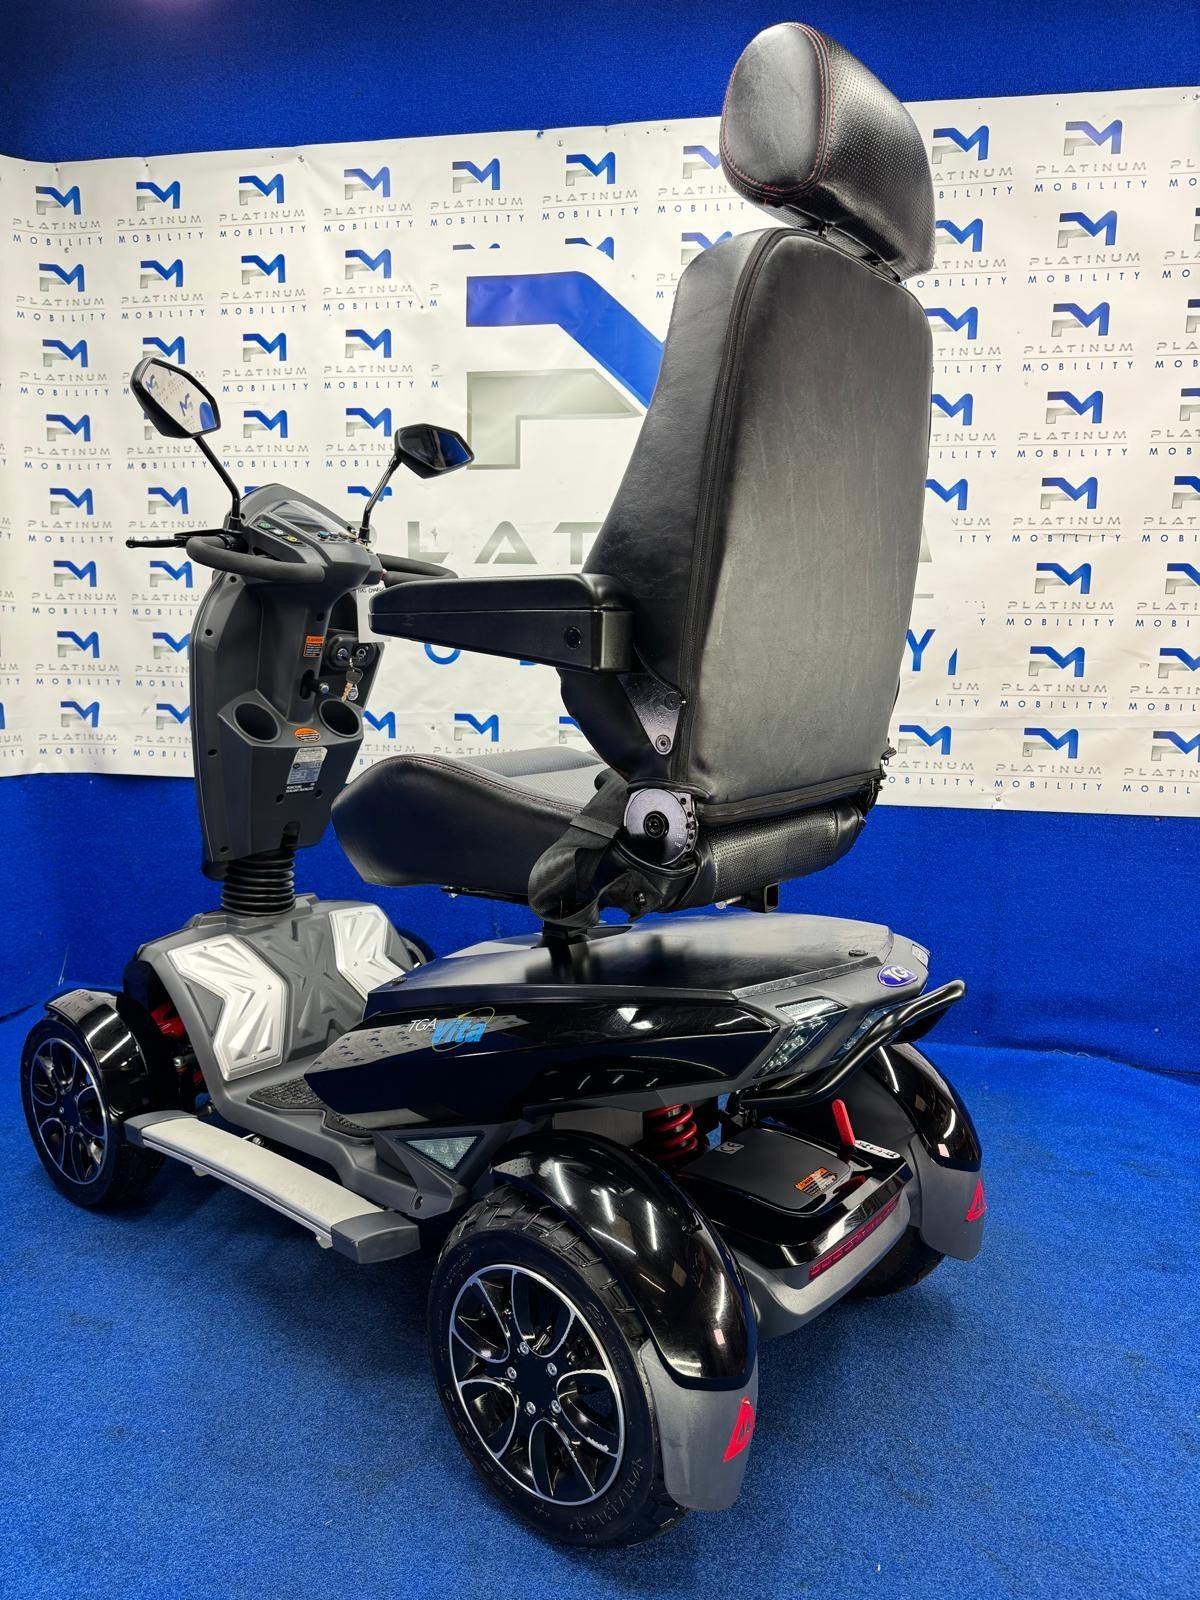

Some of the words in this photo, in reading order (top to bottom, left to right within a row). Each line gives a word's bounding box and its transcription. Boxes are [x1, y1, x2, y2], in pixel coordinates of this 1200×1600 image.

[1036, 162, 1146, 174] PLATINUM
[1034, 180, 1147, 192] MOBILITY
[543, 190, 638, 203] PLATINUM
[431, 198, 522, 209] PLATINUM
[658, 202, 747, 213] MOBILIT
[323, 203, 412, 216] PLATINUM
[543, 207, 638, 220] MOBILITY
[219, 209, 305, 222] PLATINUM
[431, 214, 524, 226] MOBILITY
[13, 218, 101, 230] PLATINUM
[117, 216, 202, 226] PLATINUM
[323, 220, 414, 232] MOBILITY
[220, 225, 306, 237] MOBILITY
[13, 234, 103, 246] MOBILITY
[118, 232, 204, 243] MOBILITY
[1029, 252, 1140, 266] PLATINUM
[1028, 272, 1140, 284] MOBILITY
[220, 288, 306, 300] PLATINUM
[323, 284, 413, 295] PLATINUM
[16, 296, 105, 306] PLATINUM
[121, 294, 204, 304] PLATINUM
[221, 305, 307, 317] MOBILITY
[323, 300, 413, 312] MOBILITY
[17, 311, 106, 322] MOBILITY
[122, 310, 205, 319] MOBILITY
[1024, 342, 1133, 353] PLATINUM
[323, 364, 413, 375] PLATINUM
[1023, 361, 1133, 372] MOBILITY
[19, 371, 108, 382] PLATINUM
[223, 368, 307, 377] PLATINUM
[223, 382, 308, 392] MOBILITY
[323, 379, 414, 390] MOBILITY
[20, 387, 109, 397] MOBILITY
[1018, 430, 1127, 440] PLATINUM
[24, 447, 111, 456] PLATINUM
[223, 444, 309, 454] PLATINUM
[1017, 448, 1127, 458] MOBILITY
[24, 461, 111, 471] MOBILITY
[127, 460, 206, 470] MOBILITY
[224, 459, 310, 469] MOBILITY
[27, 520, 113, 529] PLATINUM
[128, 520, 208, 528] PLATINUM
[1013, 517, 1120, 526] PLATINUM
[29, 535, 113, 544] MOBILITY
[1012, 535, 1121, 543] MOBILITY
[32, 592, 116, 601] PLATINUM
[32, 606, 117, 615] MOBILITY
[1008, 601, 1113, 610] PLATINUM
[1007, 618, 1114, 627] MOBILITY
[35, 663, 120, 672] PLATINUM
[36, 678, 121, 686] MOBILITY
[1001, 684, 1107, 693] PLATINUM
[1000, 700, 1107, 709] MOBILITY
[38, 734, 118, 742] PLATINUM
[39, 748, 116, 756] MOBILITY
[996, 764, 1101, 774] PLATINUM
[888, 777, 974, 786] OBILITY
[995, 780, 1101, 790] MOBILITY
[408, 1018, 437, 1032] TGA
[432, 1018, 487, 1045] Vita
